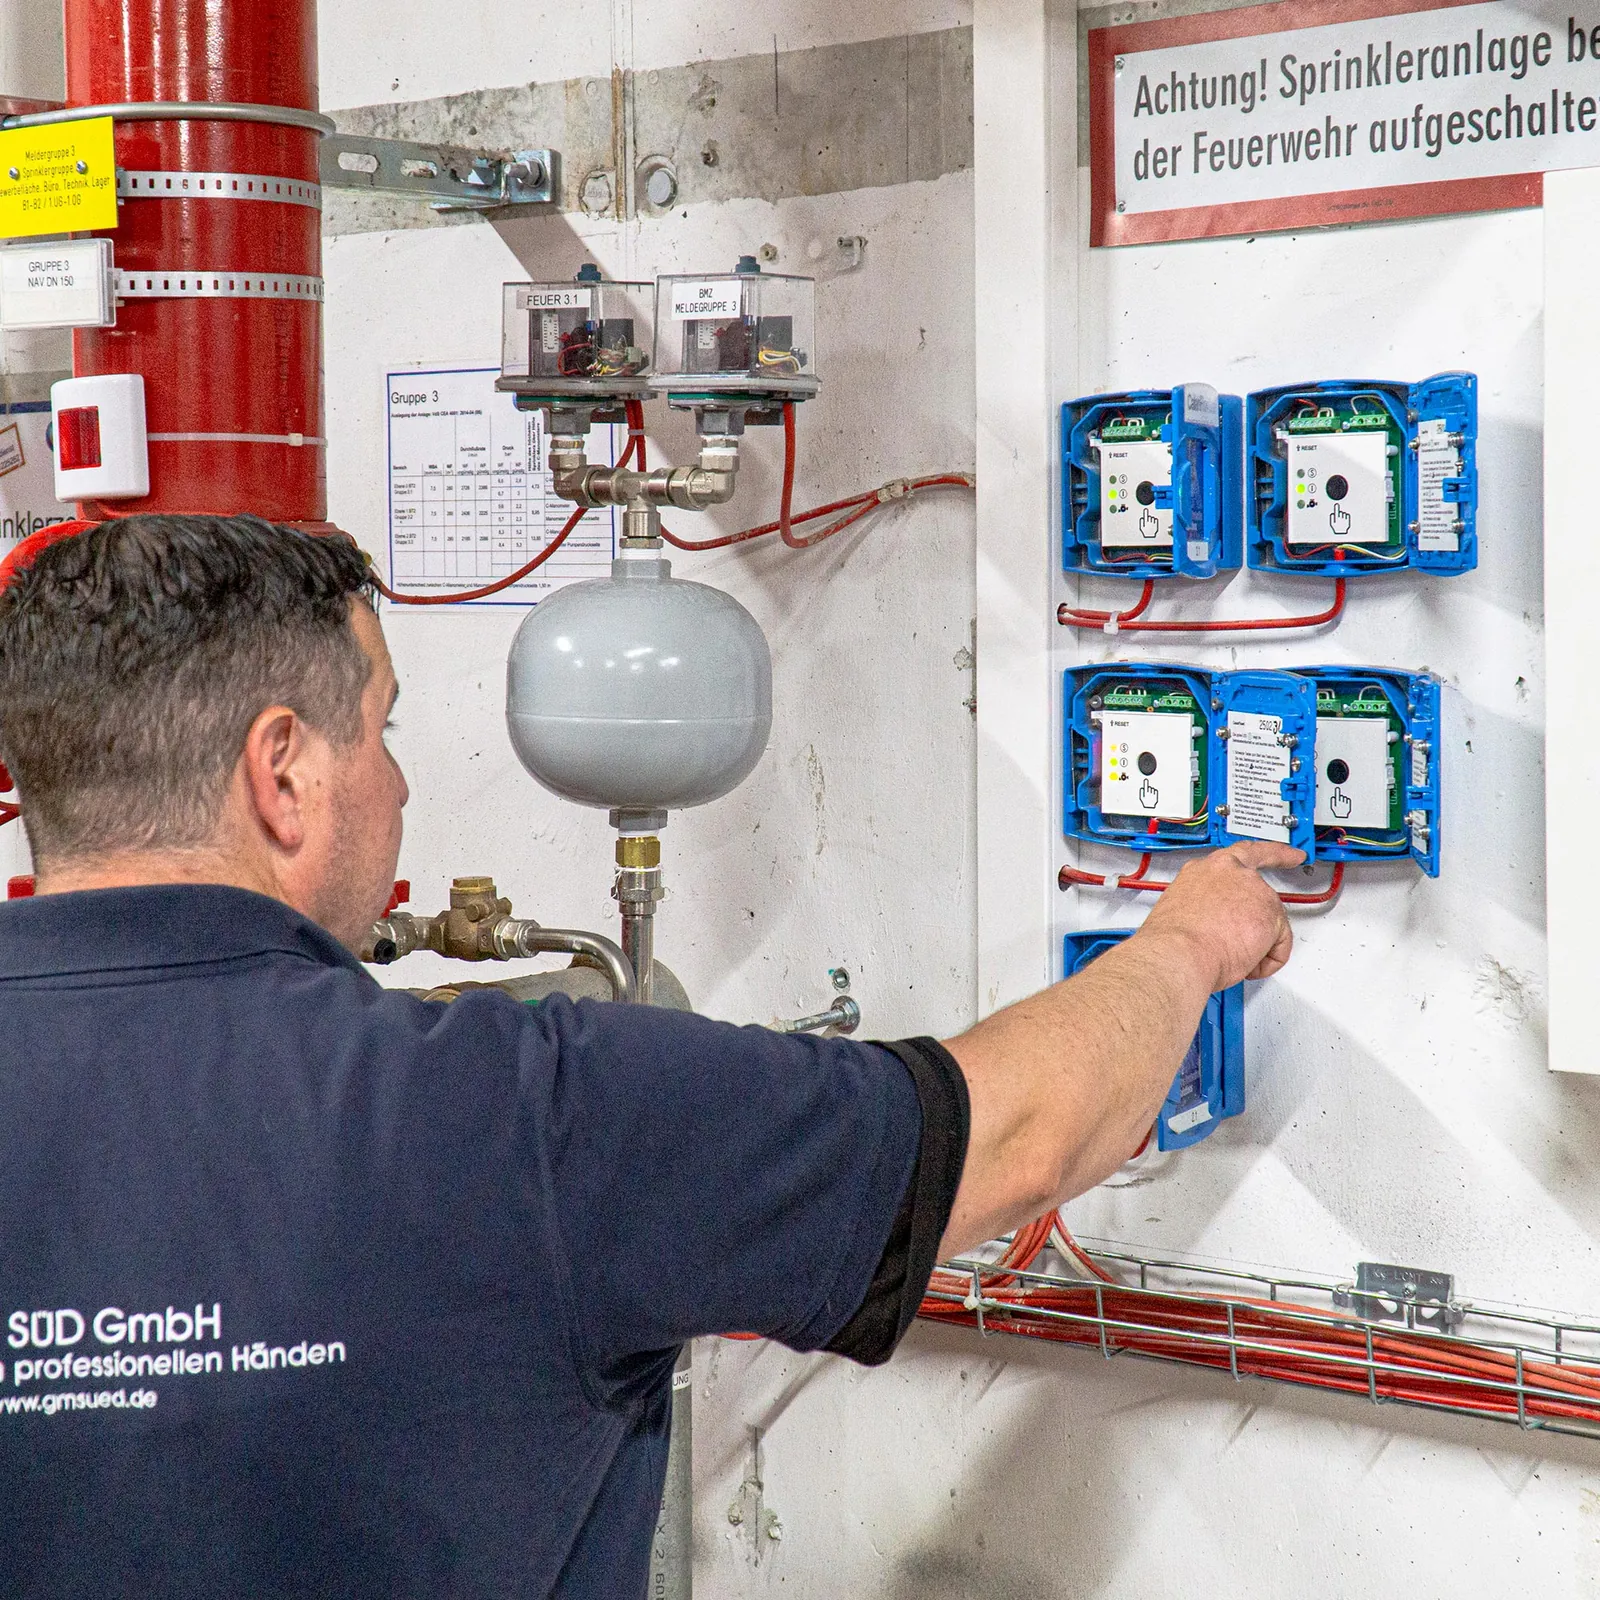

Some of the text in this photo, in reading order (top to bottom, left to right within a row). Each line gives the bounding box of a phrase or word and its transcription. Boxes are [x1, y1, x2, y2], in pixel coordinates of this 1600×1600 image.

[1133, 58, 1267, 118] Achtung!
[1279, 28, 1552, 105] Sprinkleranlage
[1133, 89, 1600, 181] der Feuerwehr aufgeschalte
[25, 145, 76, 162] Meldergruppe 3
[22, 164, 74, 178] Sprinklergruppe
[92, 176, 110, 189] Lager
[28, 260, 70, 272] GRUPPE 3
[28, 275, 74, 288] NAV DN 150
[526, 294, 578, 306] FEUER 3.1
[698, 288, 713, 298] BMZ
[675, 300, 737, 314] MELDEGRUPPE 3
[391, 390, 439, 406] Gruppe 3
[7, 1302, 222, 1348] SÜD GmbH
[14, 1348, 222, 1387] professionellen
[231, 1340, 346, 1372] Händen
[0, 1388, 158, 1415] ww.gmsued.de
[655, 1573, 664, 1600] 60
